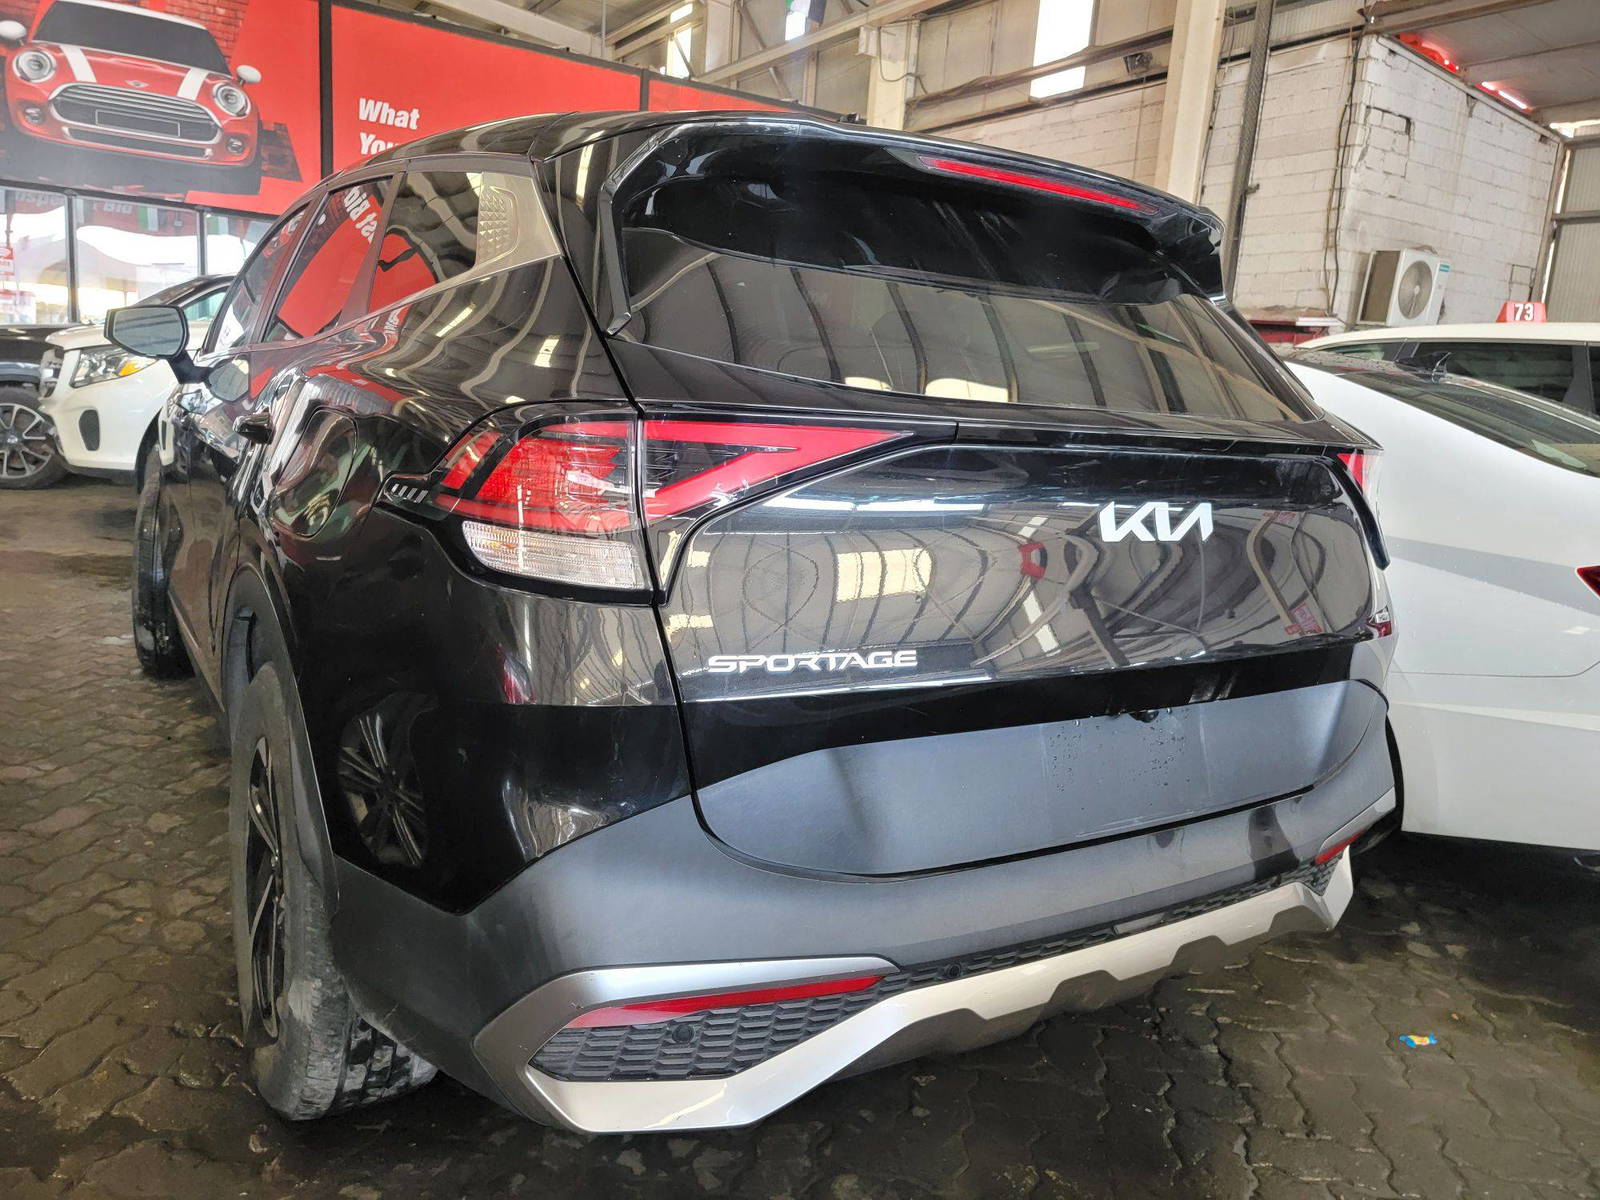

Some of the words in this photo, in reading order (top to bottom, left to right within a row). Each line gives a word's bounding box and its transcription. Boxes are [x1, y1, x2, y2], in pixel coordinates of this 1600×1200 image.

[358, 97, 420, 130] What
[359, 132, 400, 155] Yo
[1513, 303, 1534, 321] 73
[1099, 501, 1214, 542] KIA
[707, 650, 918, 673] SPORTAGE
